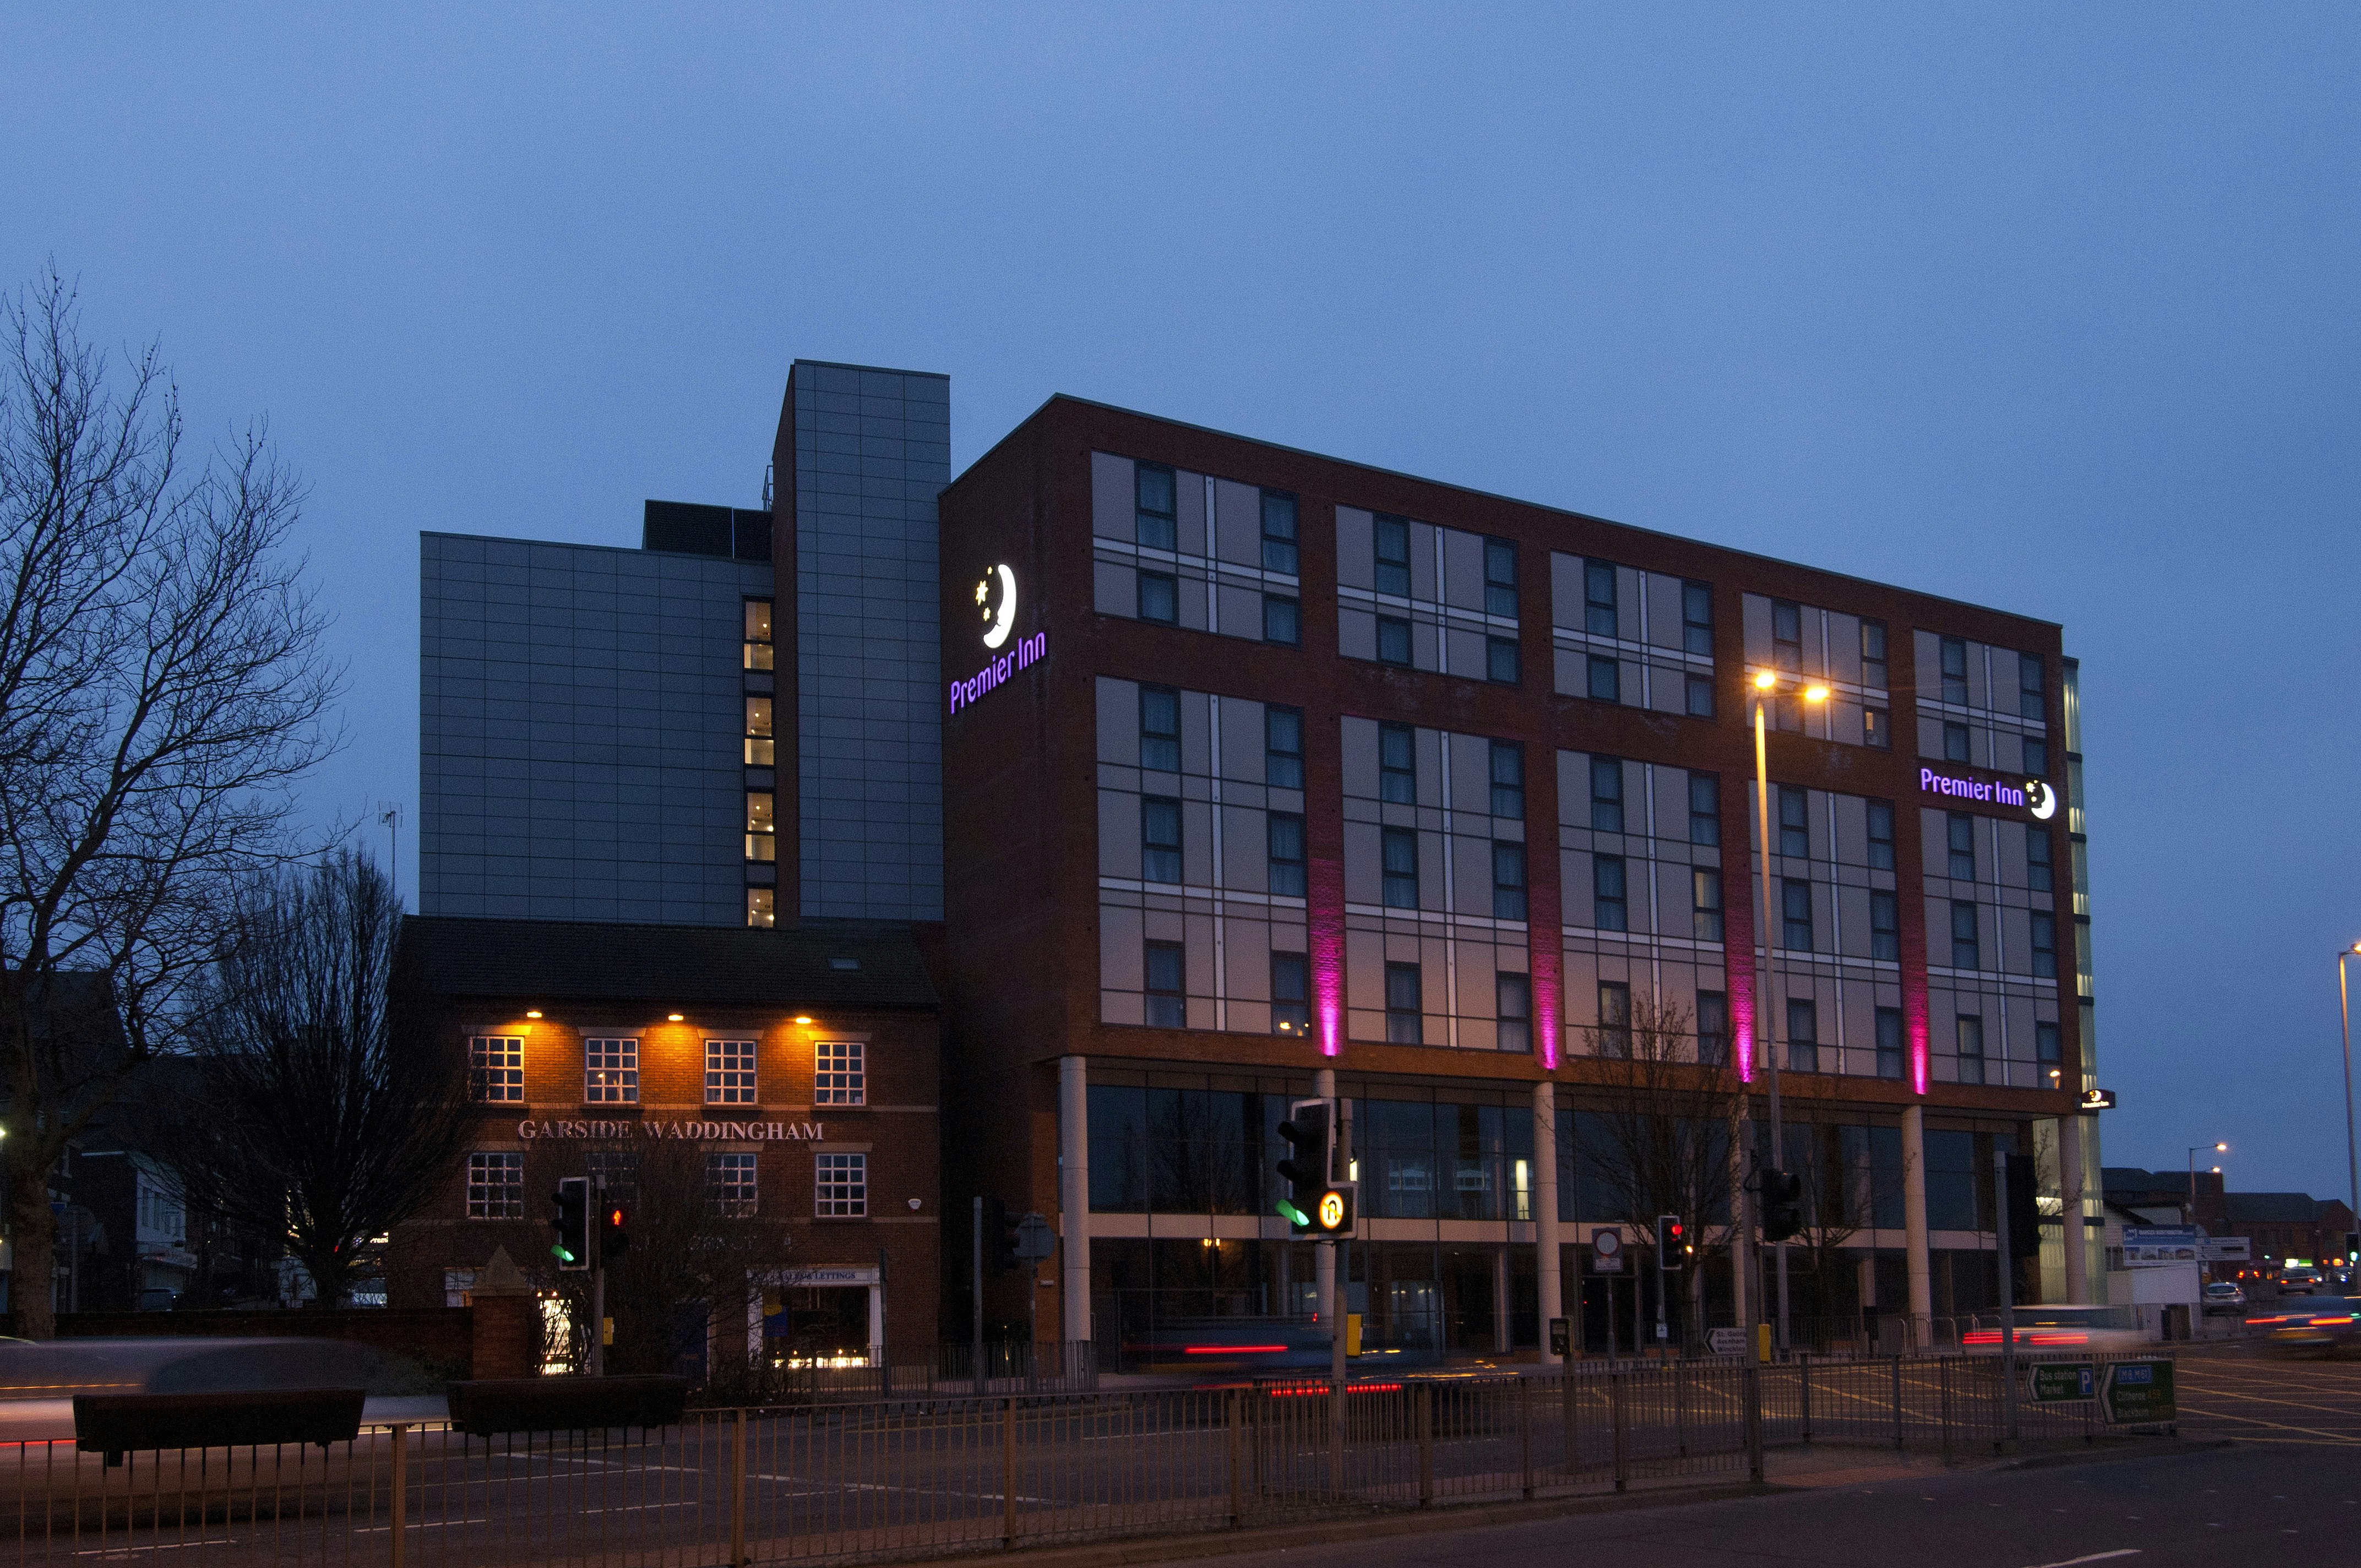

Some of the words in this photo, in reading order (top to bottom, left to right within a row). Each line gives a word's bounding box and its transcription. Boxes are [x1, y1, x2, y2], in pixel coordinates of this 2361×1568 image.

[950, 650, 1015, 715] Premier
[1018, 631, 1046, 671] Inn
[1920, 768, 1994, 801] Premier
[1995, 781, 2024, 807] Inn
[518, 1120, 633, 1139] GARSIDE
[642, 1121, 824, 1140] WADDINGHAM
[815, 1271, 856, 1280] LETTINGS
[2039, 1370, 2053, 1381] Bus
[2053, 1370, 2077, 1381] station
